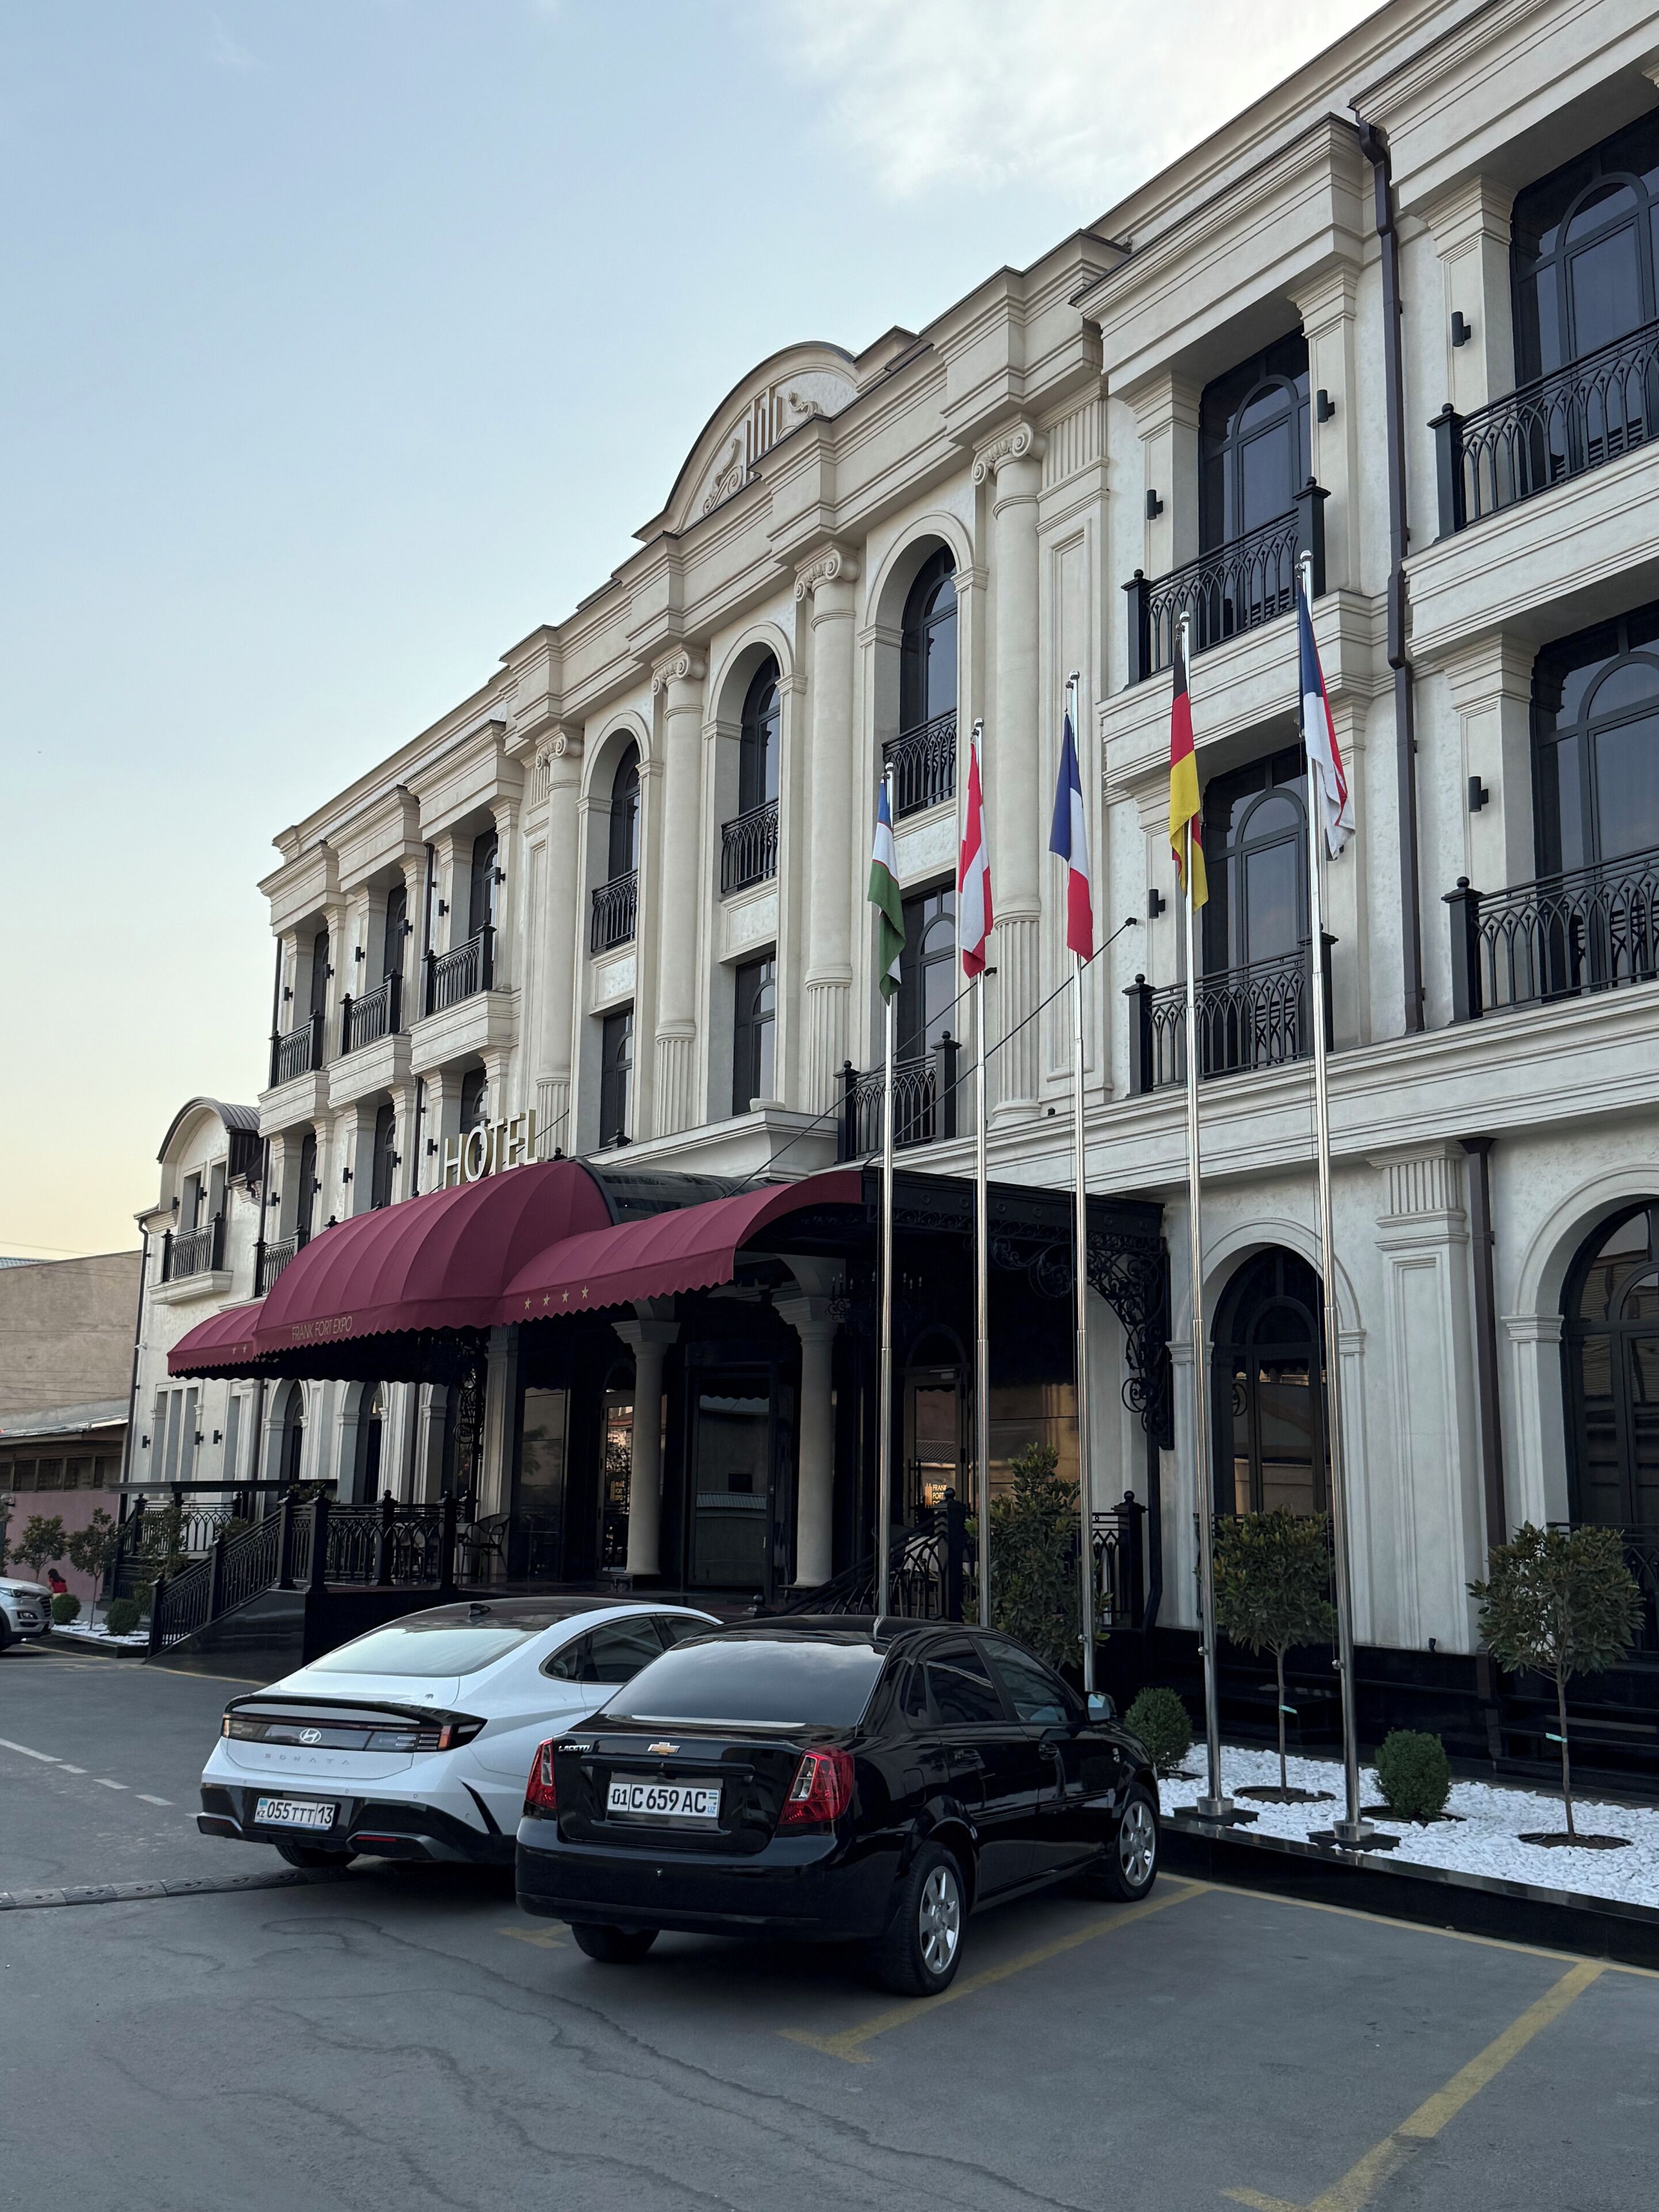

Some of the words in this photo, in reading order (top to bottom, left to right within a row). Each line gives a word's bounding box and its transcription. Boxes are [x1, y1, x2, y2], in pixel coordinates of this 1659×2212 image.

[443, 1109, 543, 1190] HOTEL
[291, 1323, 314, 1341] FRANK
[315, 1319, 333, 1336] FORT
[333, 1316, 353, 1334] EXPO
[612, 1789, 627, 1805] 01
[318, 1806, 334, 1824] 13
